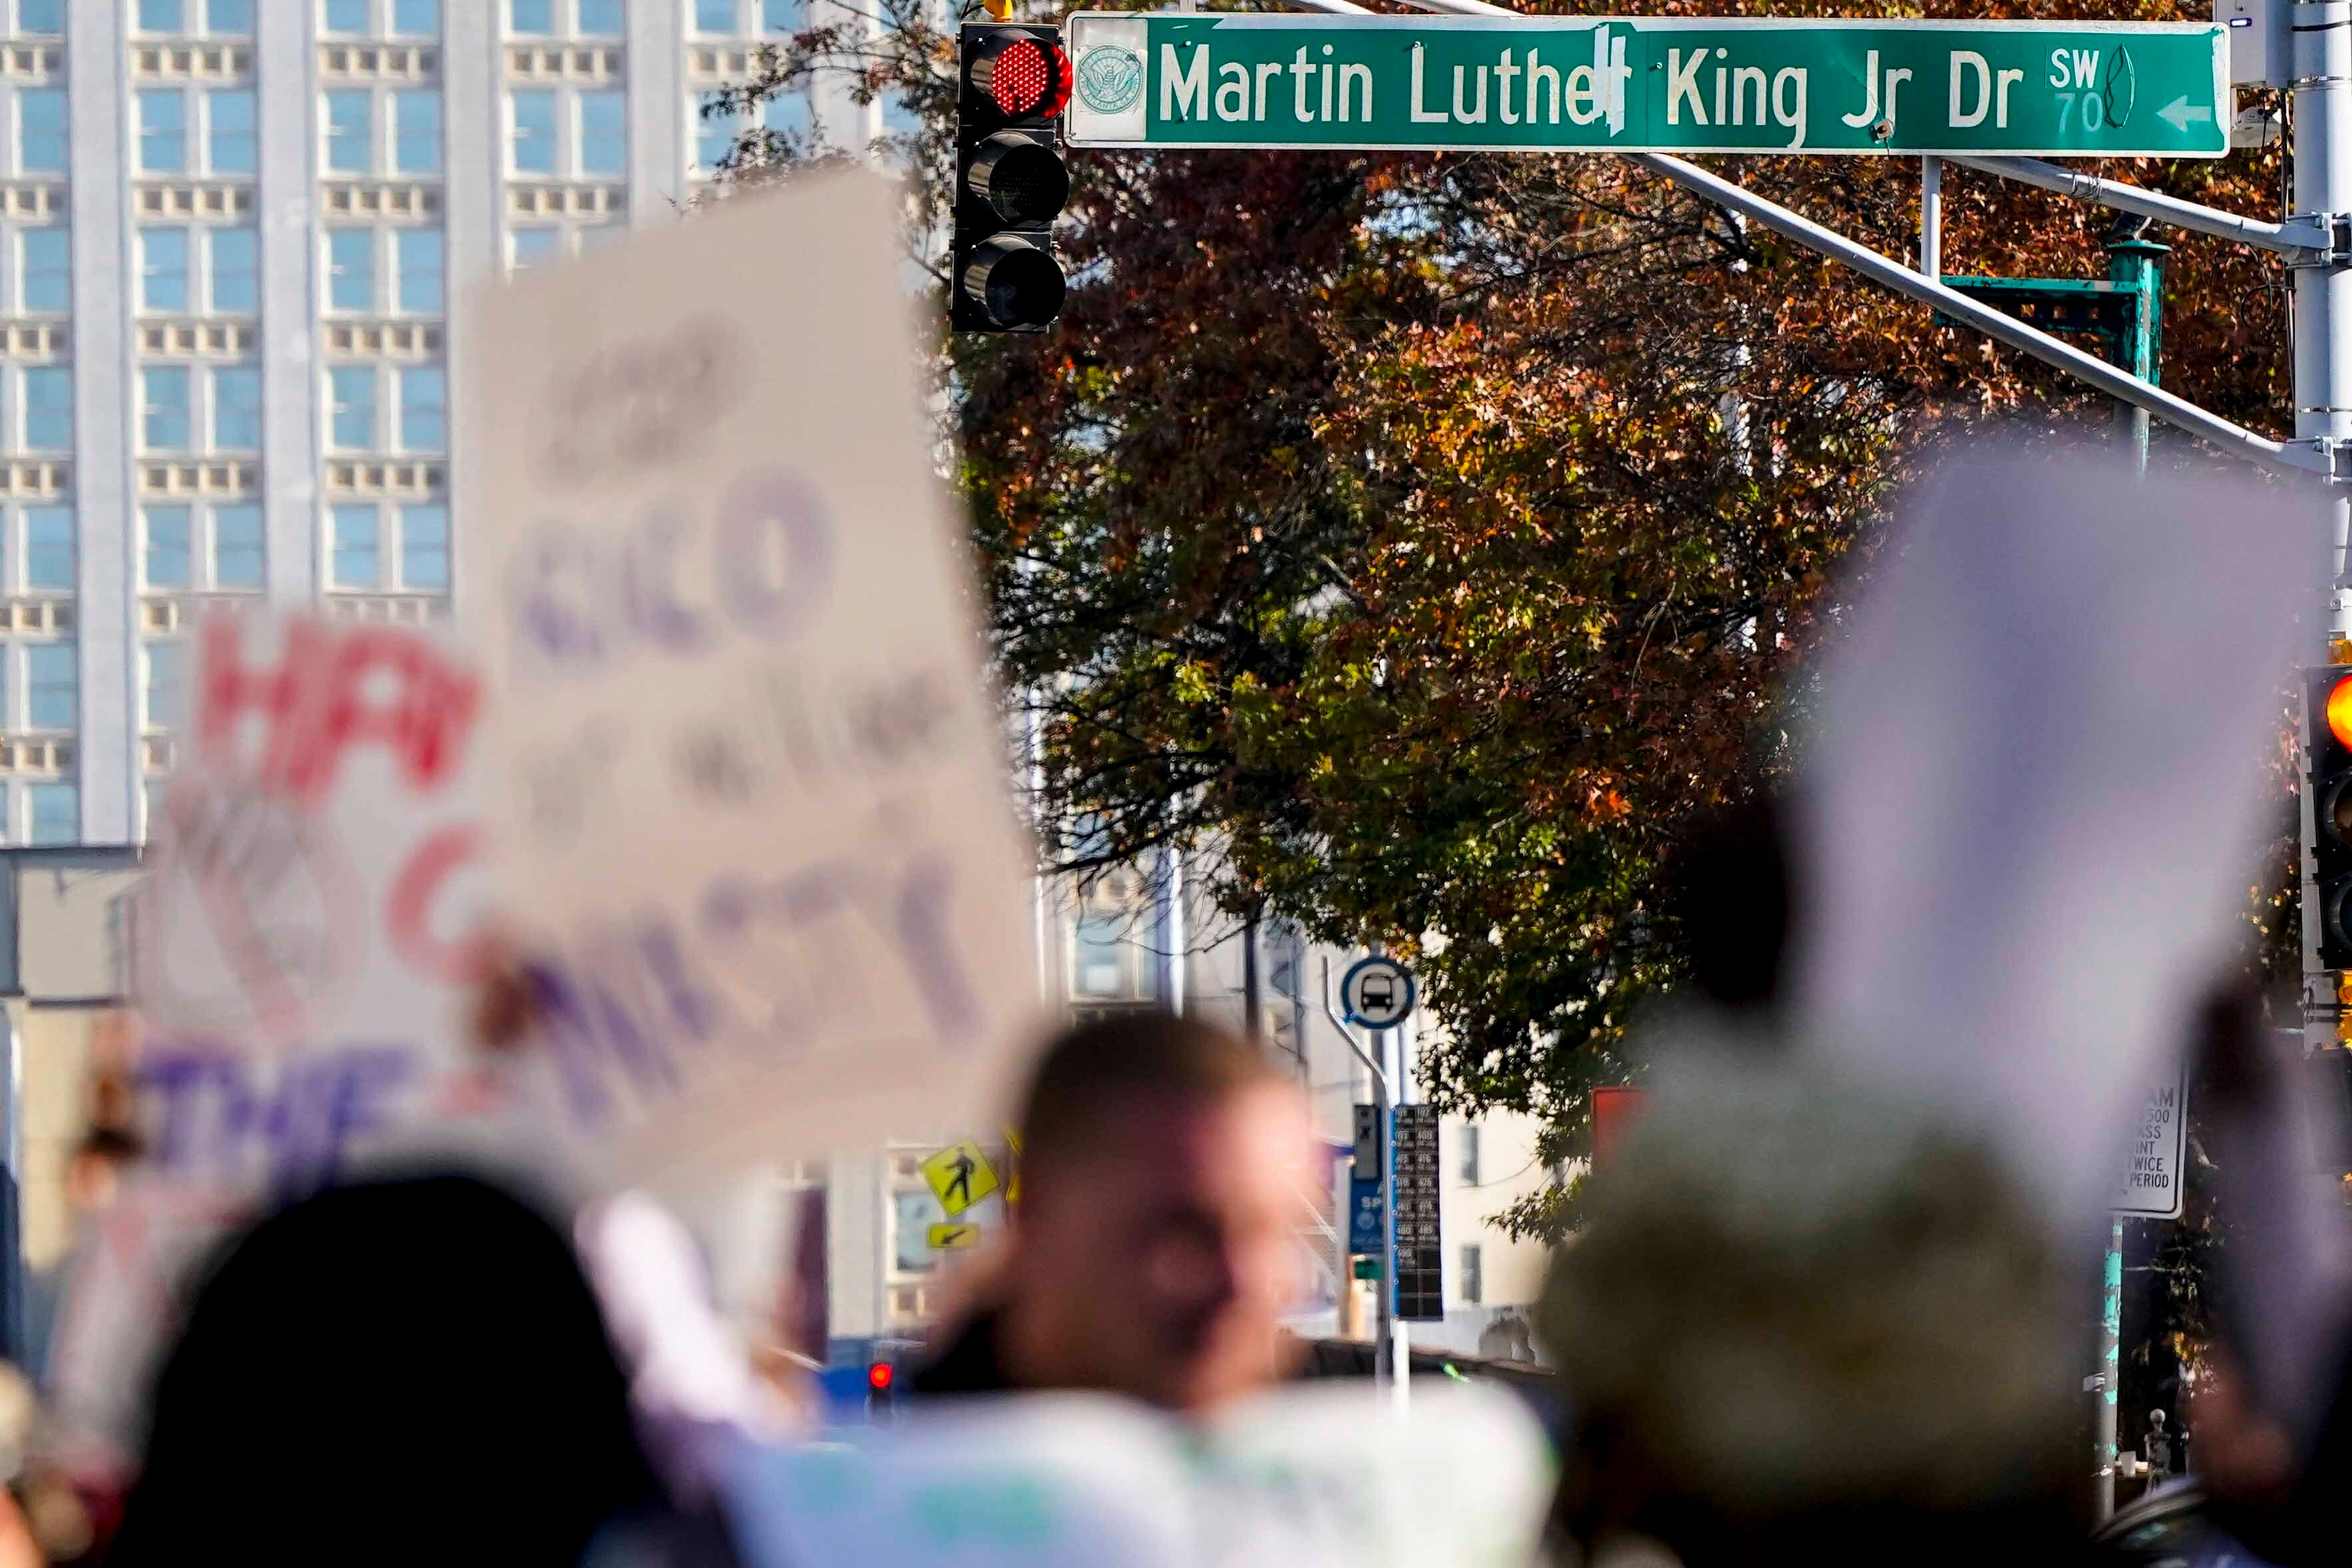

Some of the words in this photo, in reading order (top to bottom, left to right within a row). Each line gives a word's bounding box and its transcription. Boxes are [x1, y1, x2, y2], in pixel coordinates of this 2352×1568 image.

[1160, 44, 1373, 122] Martin
[1666, 47, 1808, 148] King
[1841, 50, 1914, 129] Jr
[1949, 51, 2024, 128] Dr
[2049, 48, 2100, 88] SW
[2055, 92, 2103, 133] 70
[2130, 1173, 2170, 1188] PERIOD
